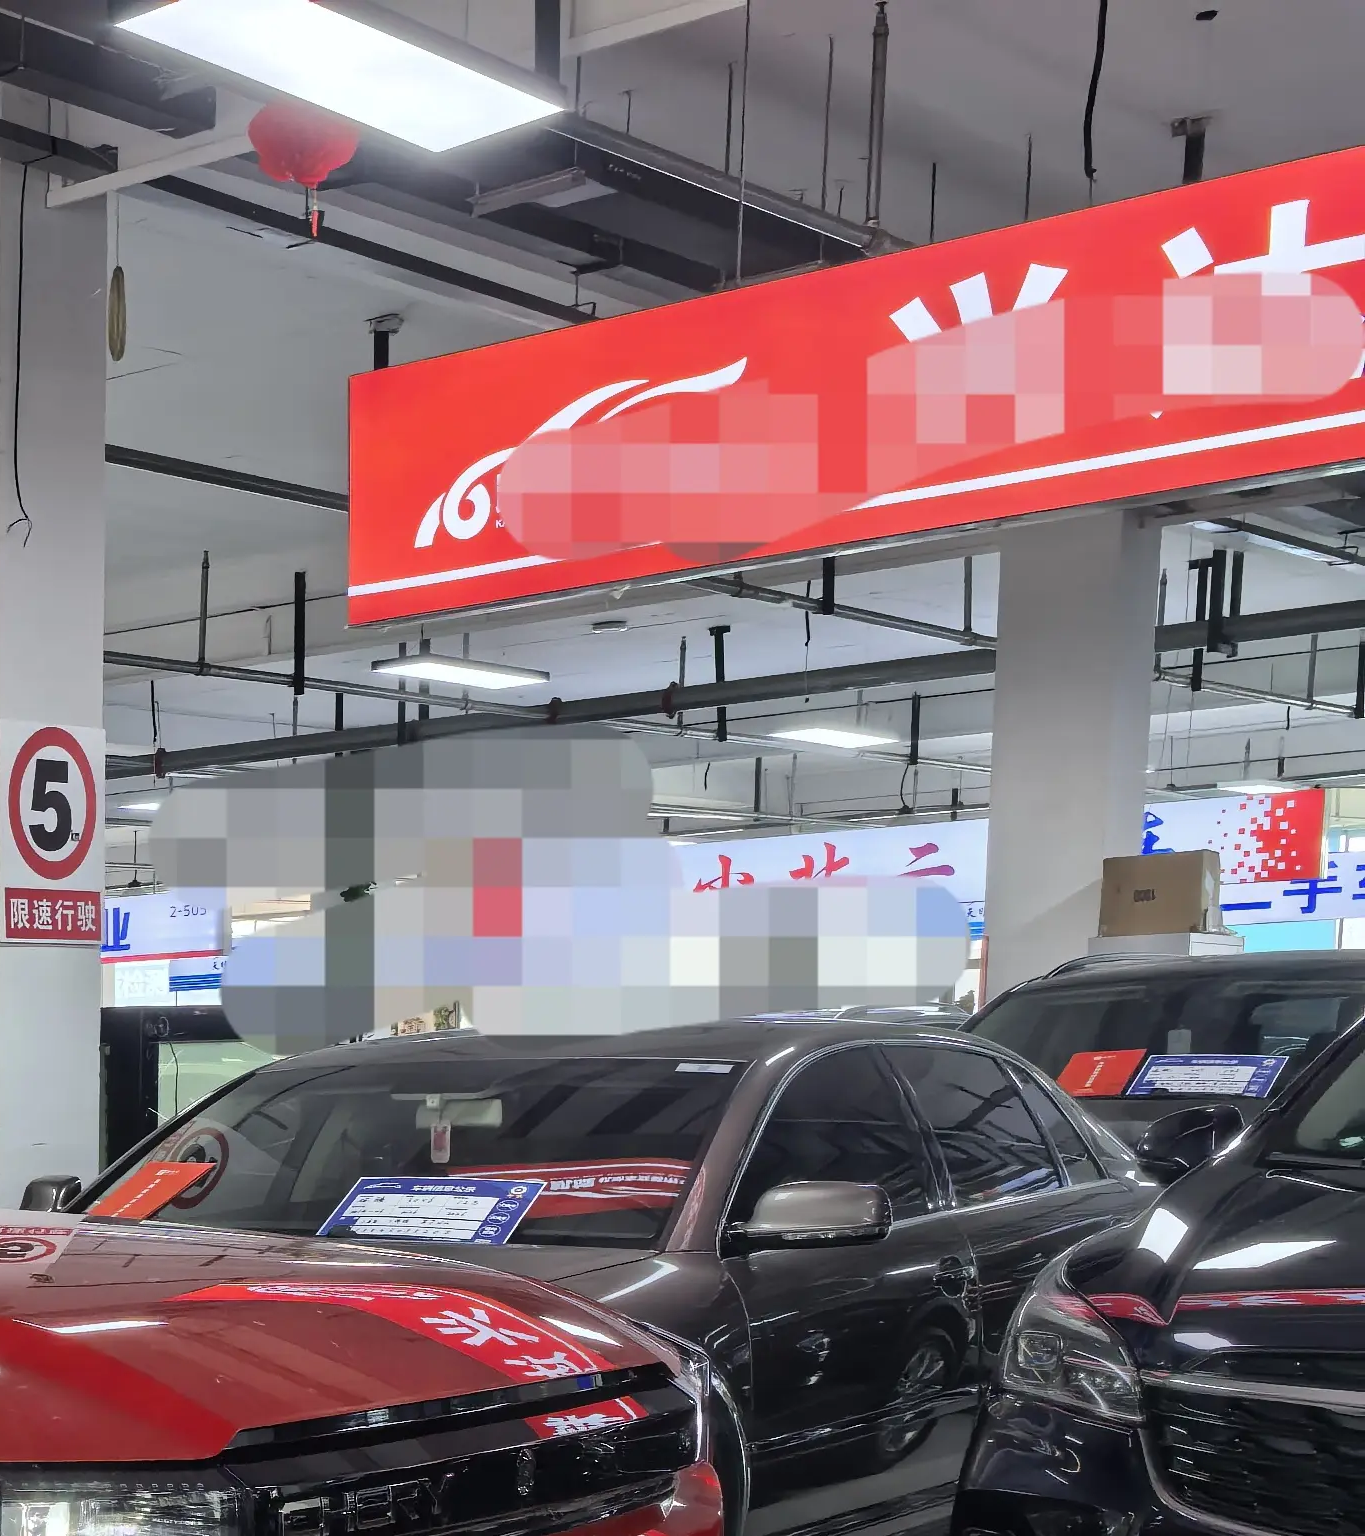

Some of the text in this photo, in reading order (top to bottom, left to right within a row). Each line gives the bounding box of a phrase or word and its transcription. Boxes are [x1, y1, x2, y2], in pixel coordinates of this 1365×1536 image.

[29, 758, 72, 852] 5
[9, 898, 97, 932] 限速行驶
